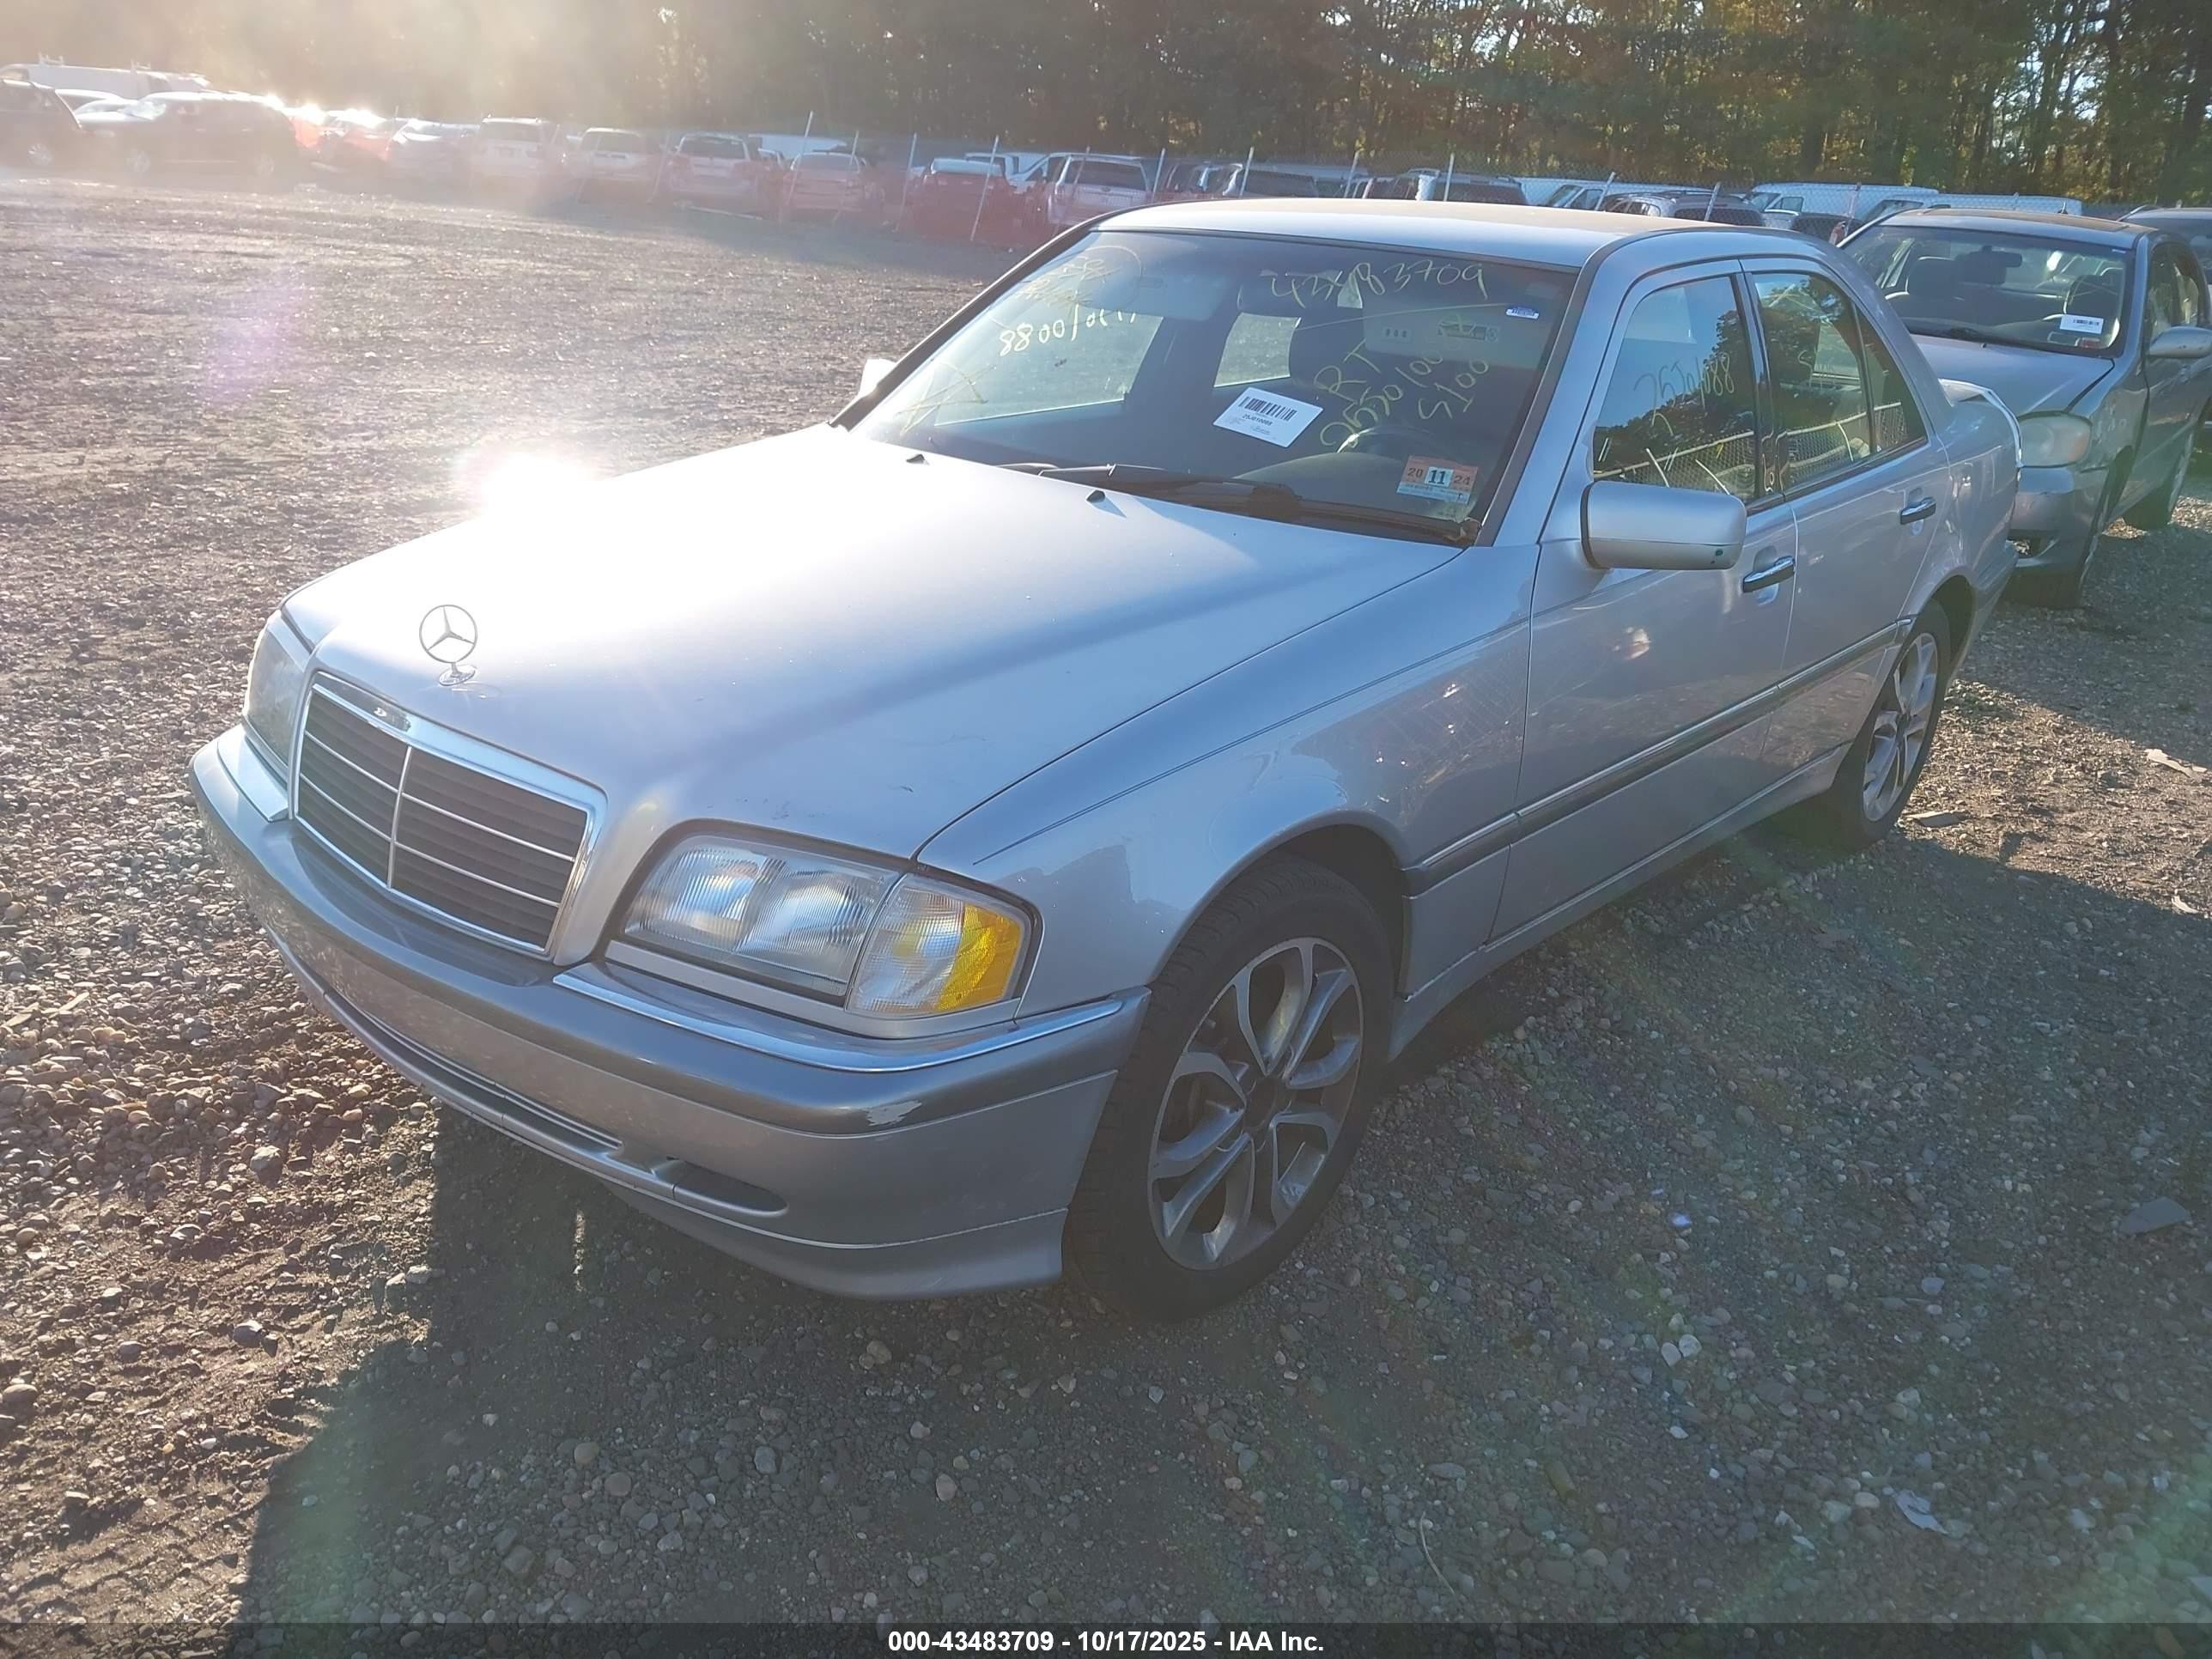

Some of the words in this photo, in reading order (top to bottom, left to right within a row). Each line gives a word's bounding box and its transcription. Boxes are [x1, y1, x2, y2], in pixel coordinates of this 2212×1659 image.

[1313, 338, 1382, 404] RT
[1407, 467, 1424, 478] 20
[1428, 469, 1447, 485] 11
[1453, 475, 1471, 486] 24
